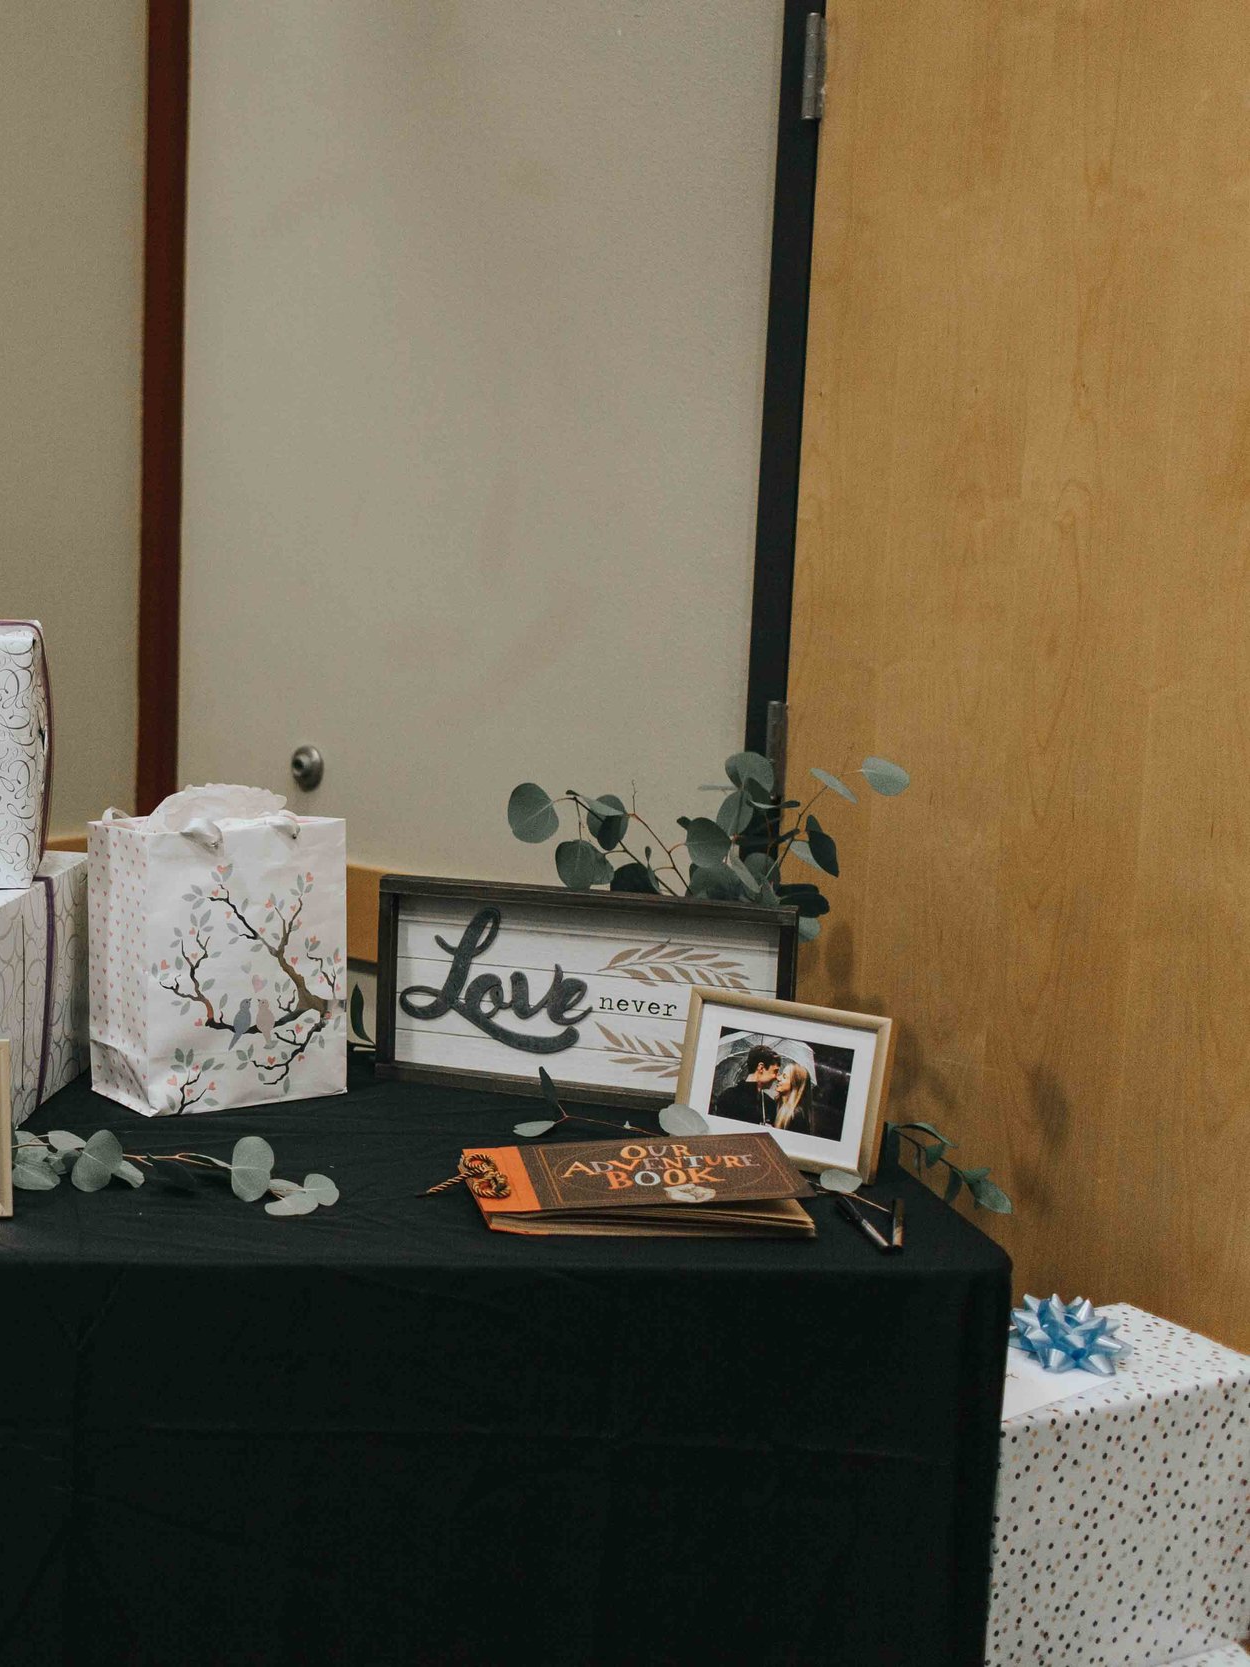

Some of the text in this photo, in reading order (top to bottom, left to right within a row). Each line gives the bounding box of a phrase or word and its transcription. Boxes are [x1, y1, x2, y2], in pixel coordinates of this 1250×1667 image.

[399, 906, 678, 1055] Love never
[619, 1144, 692, 1161] OUR
[561, 1154, 761, 1178] ADVENTURE
[606, 1167, 727, 1190] BOOK
